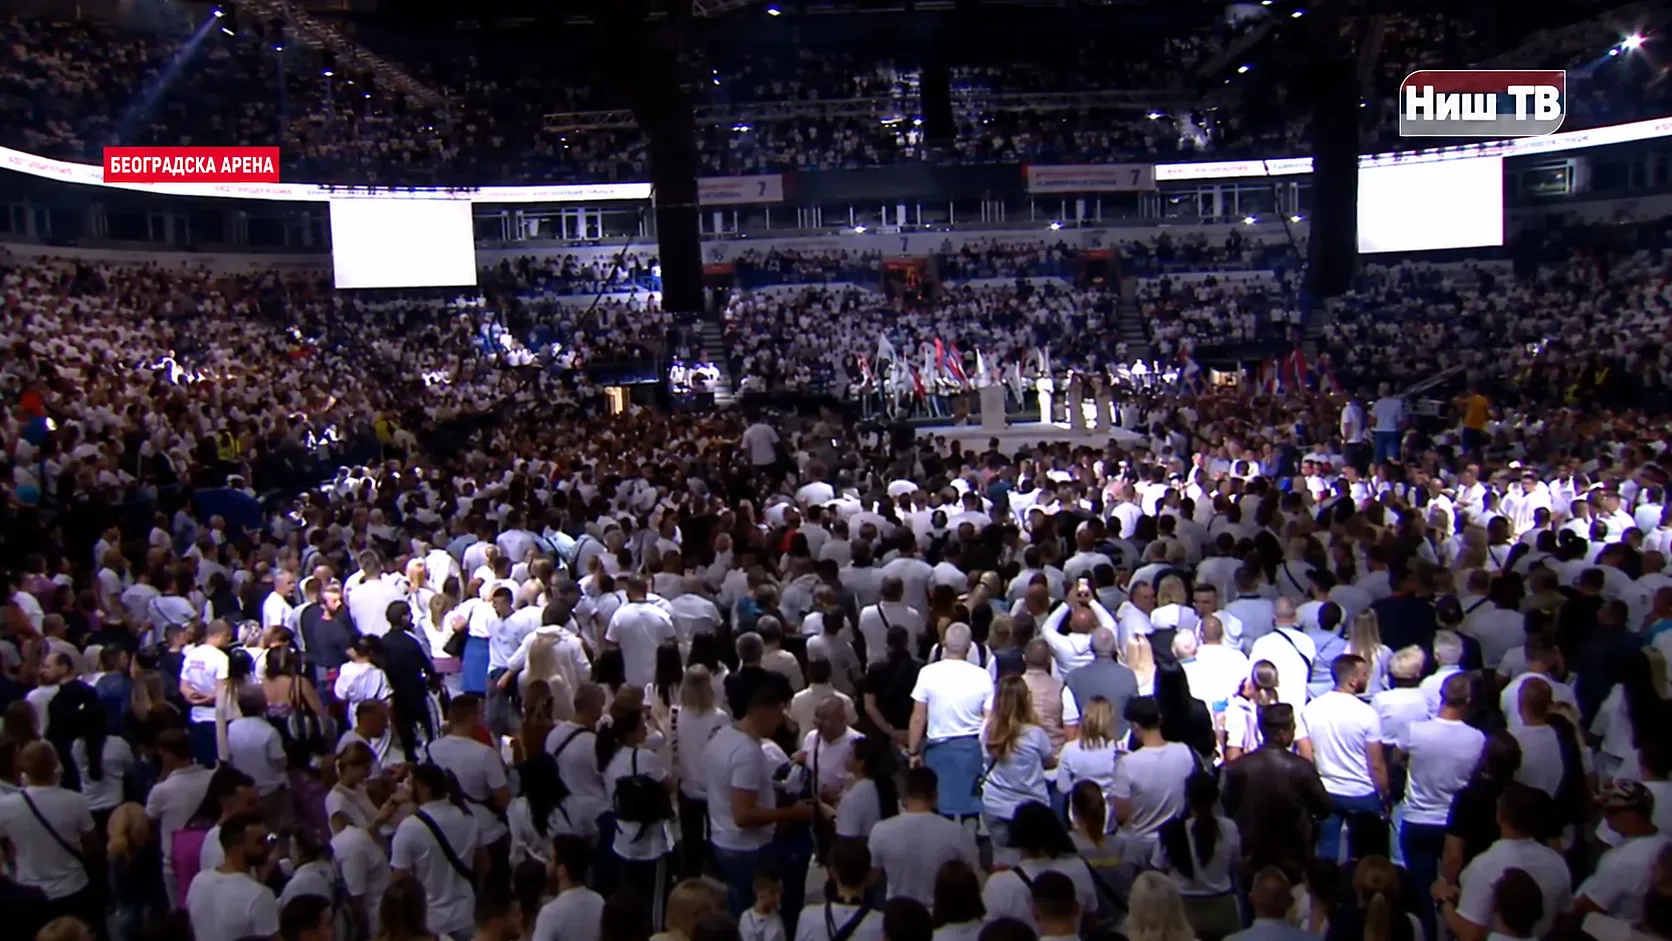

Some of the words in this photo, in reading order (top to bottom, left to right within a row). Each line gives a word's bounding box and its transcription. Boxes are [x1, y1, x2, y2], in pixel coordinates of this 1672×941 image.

[1129, 168, 1141, 186] 7
[757, 181, 767, 197] 7
[899, 236, 909, 252] 7
